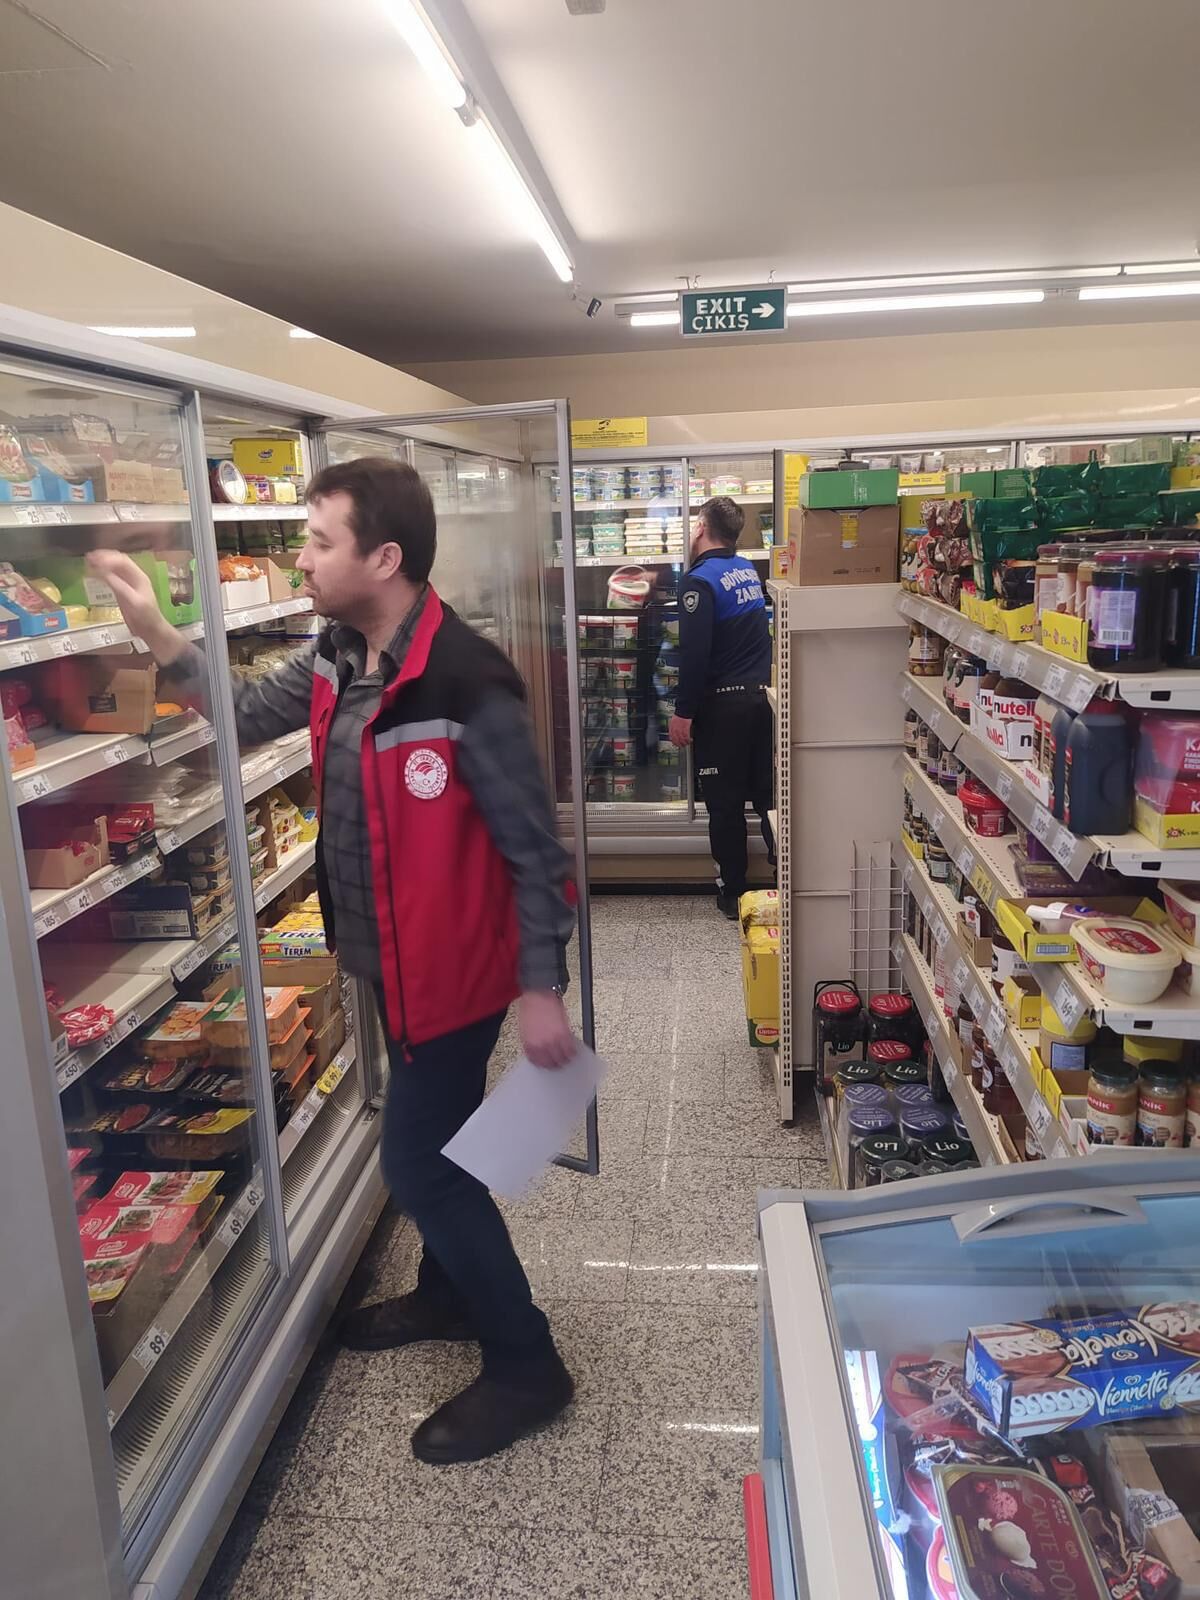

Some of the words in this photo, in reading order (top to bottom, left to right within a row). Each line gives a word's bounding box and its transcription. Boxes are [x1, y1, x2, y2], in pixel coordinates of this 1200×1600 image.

[697, 297, 746, 314] EXIT
[692, 314, 749, 334] ÇIKIŞ
[33, 781, 47, 794] 84
[78, 895, 90, 909] 42
[284, 947, 312, 956] TEREM
[127, 1015, 138, 1029] 99
[104, 1035, 114, 1049] 52
[847, 1065, 869, 1075] Lio
[896, 1065, 918, 1075] Lio
[863, 1119, 882, 1127] Lio
[921, 1119, 941, 1128] Lio
[874, 1142, 898, 1152] Lio
[936, 1142, 960, 1151] Lio
[247, 1190, 260, 1206] 60
[230, 1219, 243, 1235] 69
[149, 1334, 165, 1355] 89
[1060, 1319, 1181, 1368] Viennetta
[1091, 1369, 1170, 1417] Viennetta
